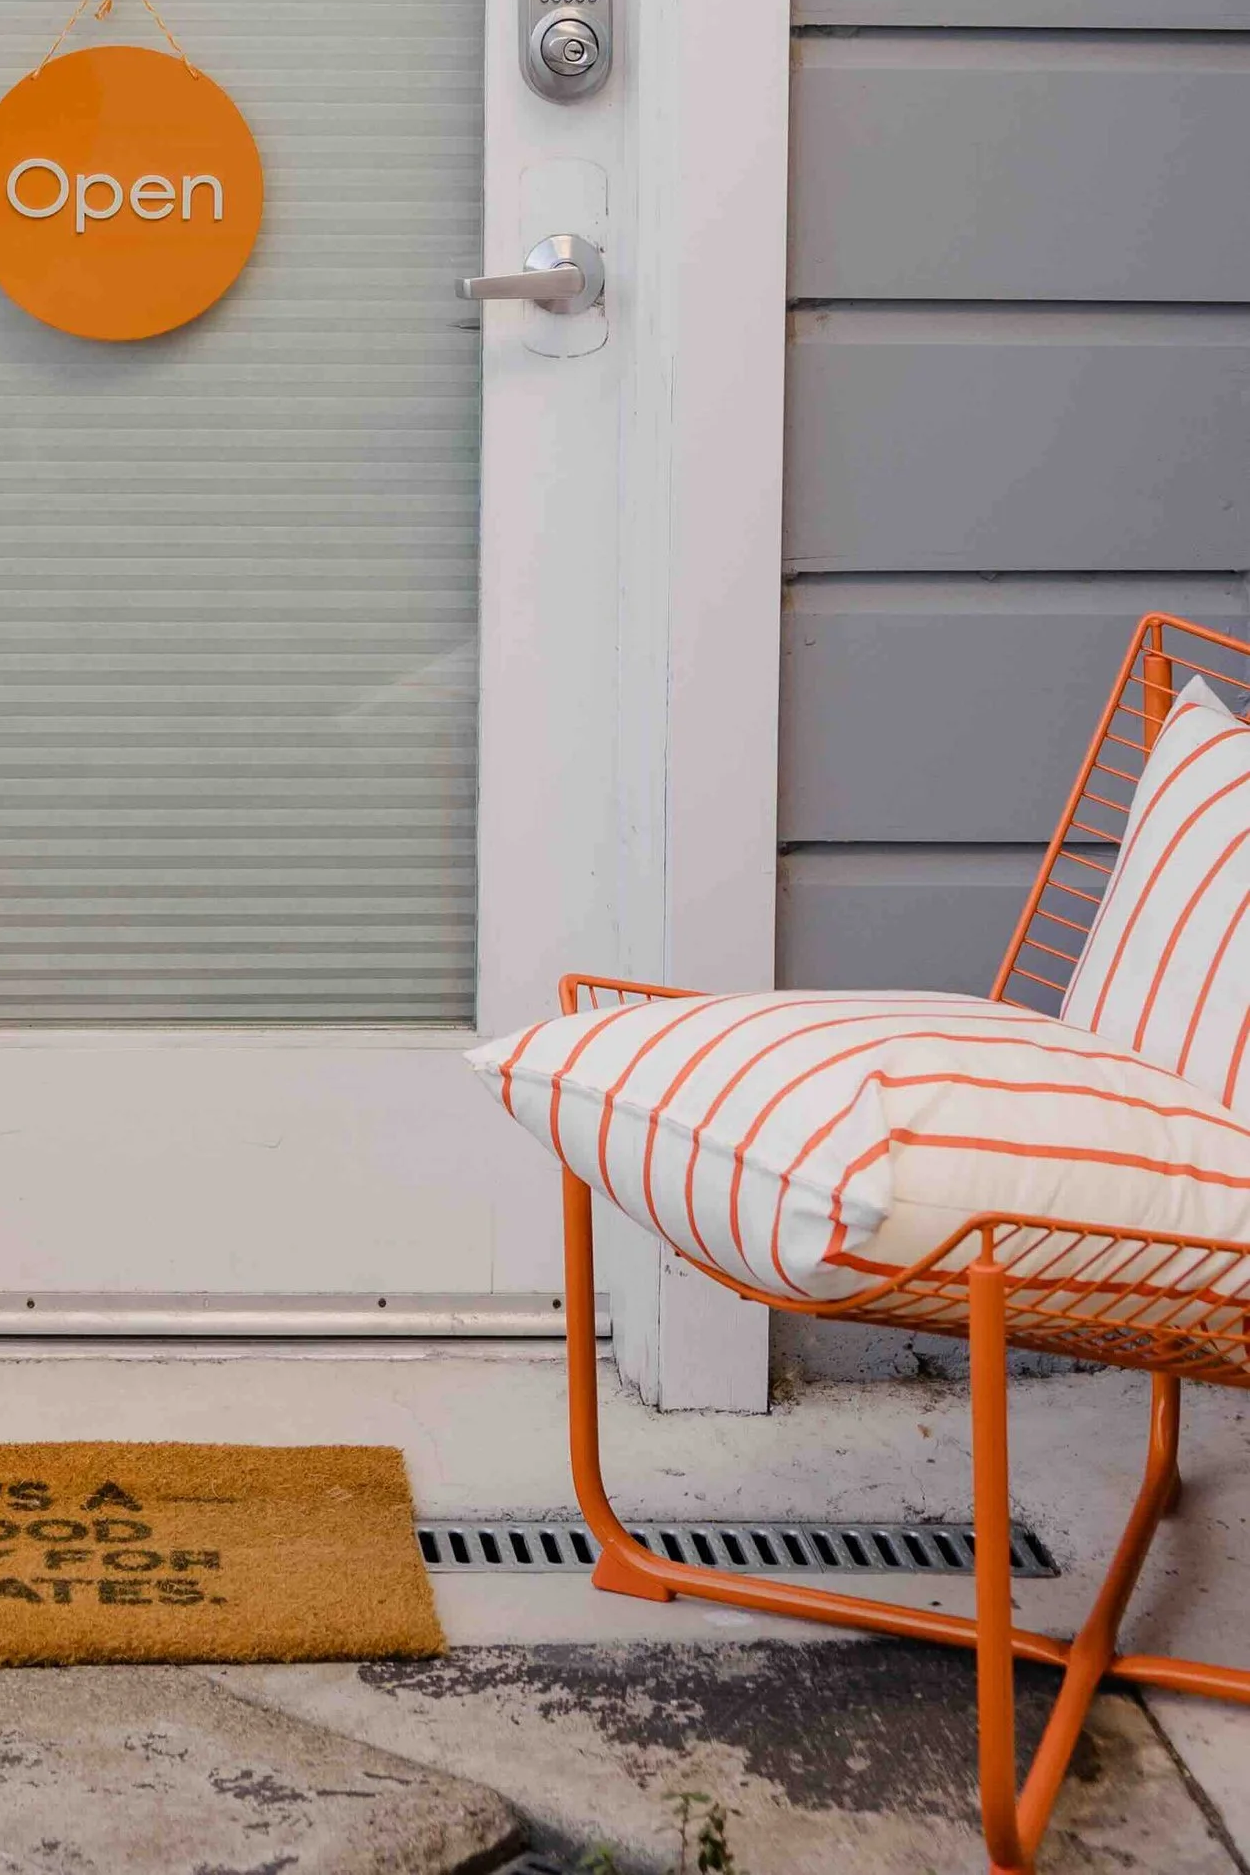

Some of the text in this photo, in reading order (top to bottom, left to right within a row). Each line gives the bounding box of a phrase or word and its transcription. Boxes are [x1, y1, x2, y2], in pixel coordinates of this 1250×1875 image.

[6, 157, 224, 234] Open
[79, 1479, 144, 1512] A
[44, 1547, 221, 1573] FOR
